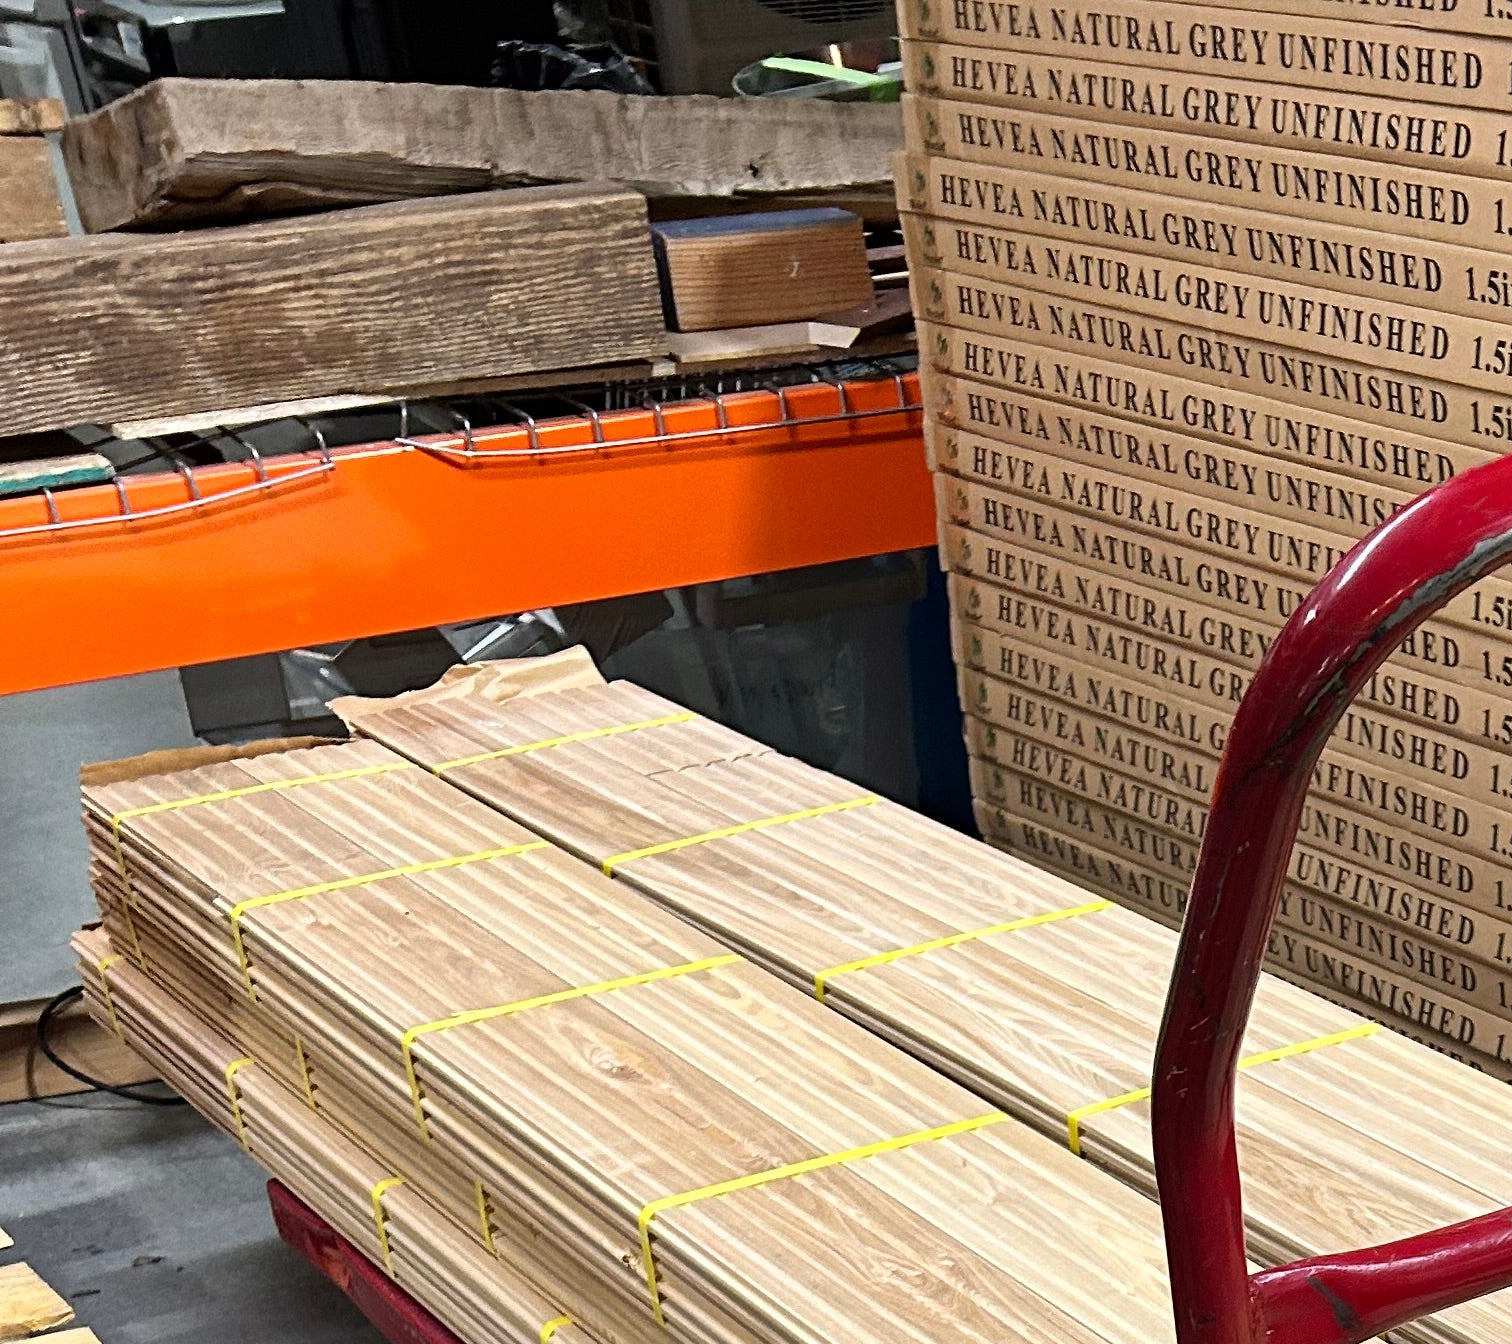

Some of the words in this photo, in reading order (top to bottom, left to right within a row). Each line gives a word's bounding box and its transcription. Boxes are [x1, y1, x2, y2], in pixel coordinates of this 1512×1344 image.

[951, 56, 1038, 99] HEVEA
[1047, 68, 1175, 118] NATURAL
[1182, 86, 1263, 131] GREY
[1271, 98, 1472, 159] UNFINISHED
[954, 1, 1041, 40] HEVEA
[1051, 8, 1181, 56] NATURAL
[1188, 22, 1269, 66] GREY
[1277, 32, 1483, 89] UNFINISHED
[939, 173, 1025, 218] HEVEA
[1030, 189, 1157, 242] NATURAL
[1162, 212, 1238, 257] GREY
[1245, 227, 1442, 293] UNFINISHED
[958, 113, 1044, 158] HEVEA
[1050, 128, 1179, 179] NATURAL
[1184, 148, 1263, 193] GREY
[1270, 162, 1470, 226] UNFINISHED
[955, 229, 1038, 275] HEVEA
[1045, 247, 1168, 303] NATURAL
[1175, 273, 1250, 320] GREY
[1258, 290, 1450, 360] UNFINISHED
[956, 285, 1041, 331] HEVEA
[1047, 304, 1172, 361] NATURAL
[1177, 333, 1250, 379] GREY
[1257, 351, 1448, 424] UNFINISHED
[964, 341, 1045, 390] HEVEA
[1053, 363, 1175, 421] NATURAL
[1181, 394, 1257, 441] GREY
[1264, 414, 1454, 483] UNFINISHED
[967, 393, 1051, 441] HEVEA
[1056, 416, 1178, 475] NATURAL
[1184, 449, 1258, 496] GREY
[1265, 470, 1404, 527] UNFINIS
[972, 445, 1051, 496] HEVEA
[1060, 471, 1179, 532] NATURAL
[1185, 507, 1260, 556] GREY
[982, 497, 1065, 548] HEVEA
[1071, 524, 1190, 587] NATURAL
[1196, 563, 1269, 611] GREY
[985, 547, 1066, 599] HEVEA
[1075, 575, 1192, 640] NATURAL
[1199, 616, 1273, 659] GREY
[997, 594, 1077, 646] HEVEA
[1085, 623, 1202, 690] NATURAL
[1332, 713, 1470, 781] INISHED
[999, 646, 1078, 699] HEVEA
[1087, 677, 1202, 744] NATURAL
[1312, 761, 1470, 838] NFINISHED
[1006, 693, 1086, 747] HEVEA
[1094, 726, 1208, 794] NATURAL
[1012, 738, 1087, 792] HEVEA
[1297, 851, 1475, 945] UNFINISHED
[1019, 778, 1095, 833] HEVEA
[1103, 813, 1197, 873] NATURA
[1300, 897, 1477, 992] UNFINISHED
[1022, 823, 1101, 878] HEVEA
[1107, 860, 1187, 912] NATUR
[1305, 945, 1475, 1045] UNFINISHED
